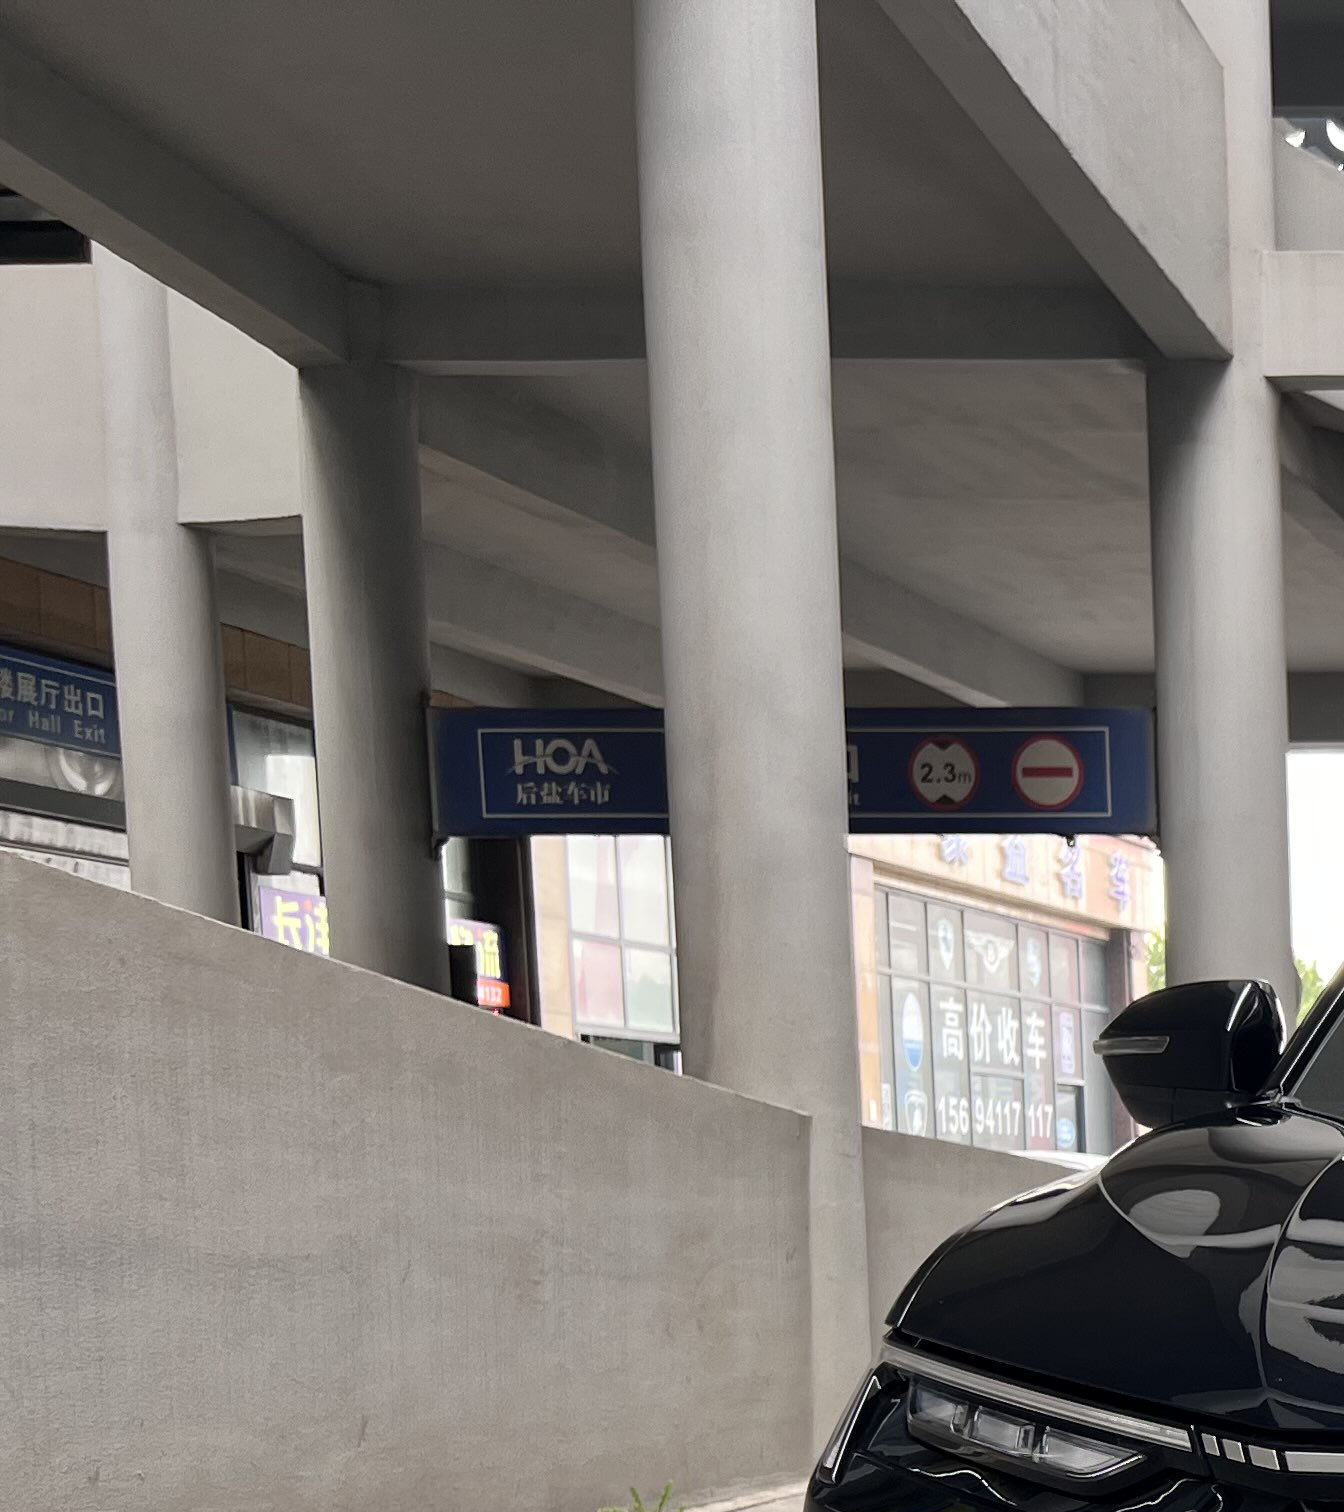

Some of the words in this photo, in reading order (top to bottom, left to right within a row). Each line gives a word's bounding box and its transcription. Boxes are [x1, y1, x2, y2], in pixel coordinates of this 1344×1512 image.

[28, 709, 61, 734] Hall
[74, 719, 106, 744] Exit
[512, 738, 609, 775] HOA
[939, 997, 1047, 1070] 高价收车
